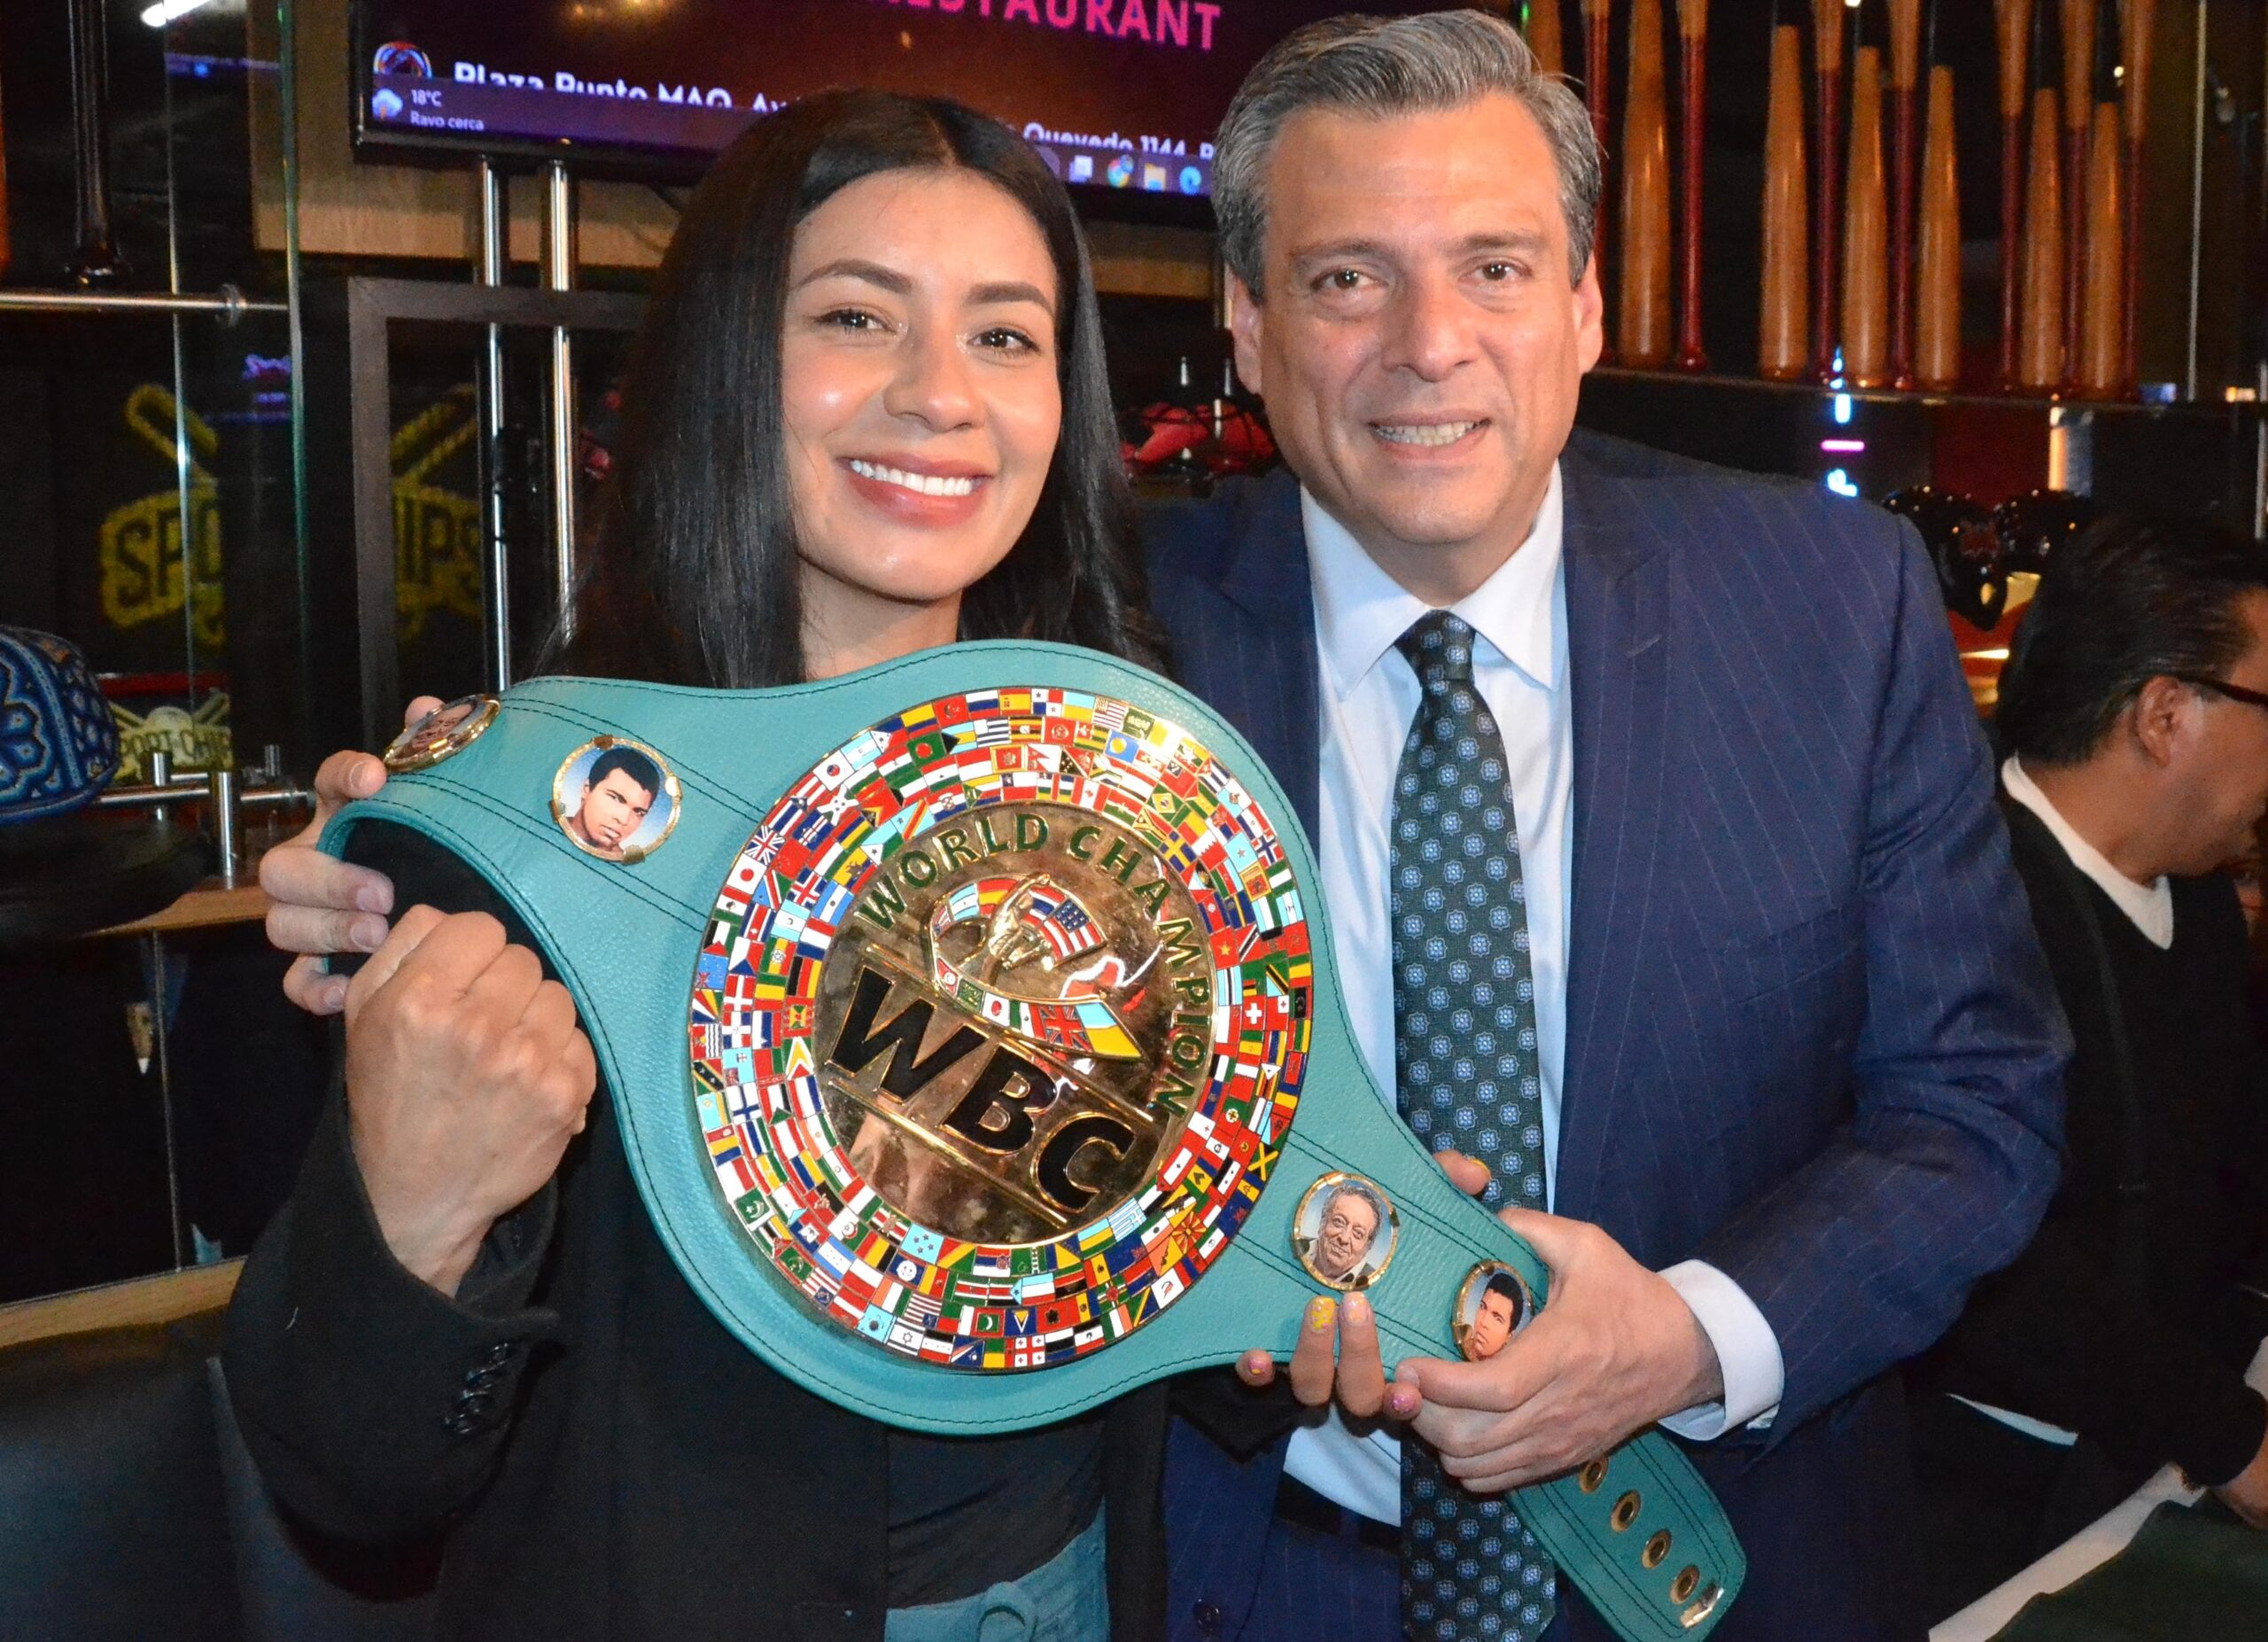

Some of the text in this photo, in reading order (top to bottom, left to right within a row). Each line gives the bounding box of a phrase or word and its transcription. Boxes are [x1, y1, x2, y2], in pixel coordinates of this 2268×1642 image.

[825, 965, 1137, 1213] WBC
[854, 812, 1210, 1118] WORLD CHAMPION
